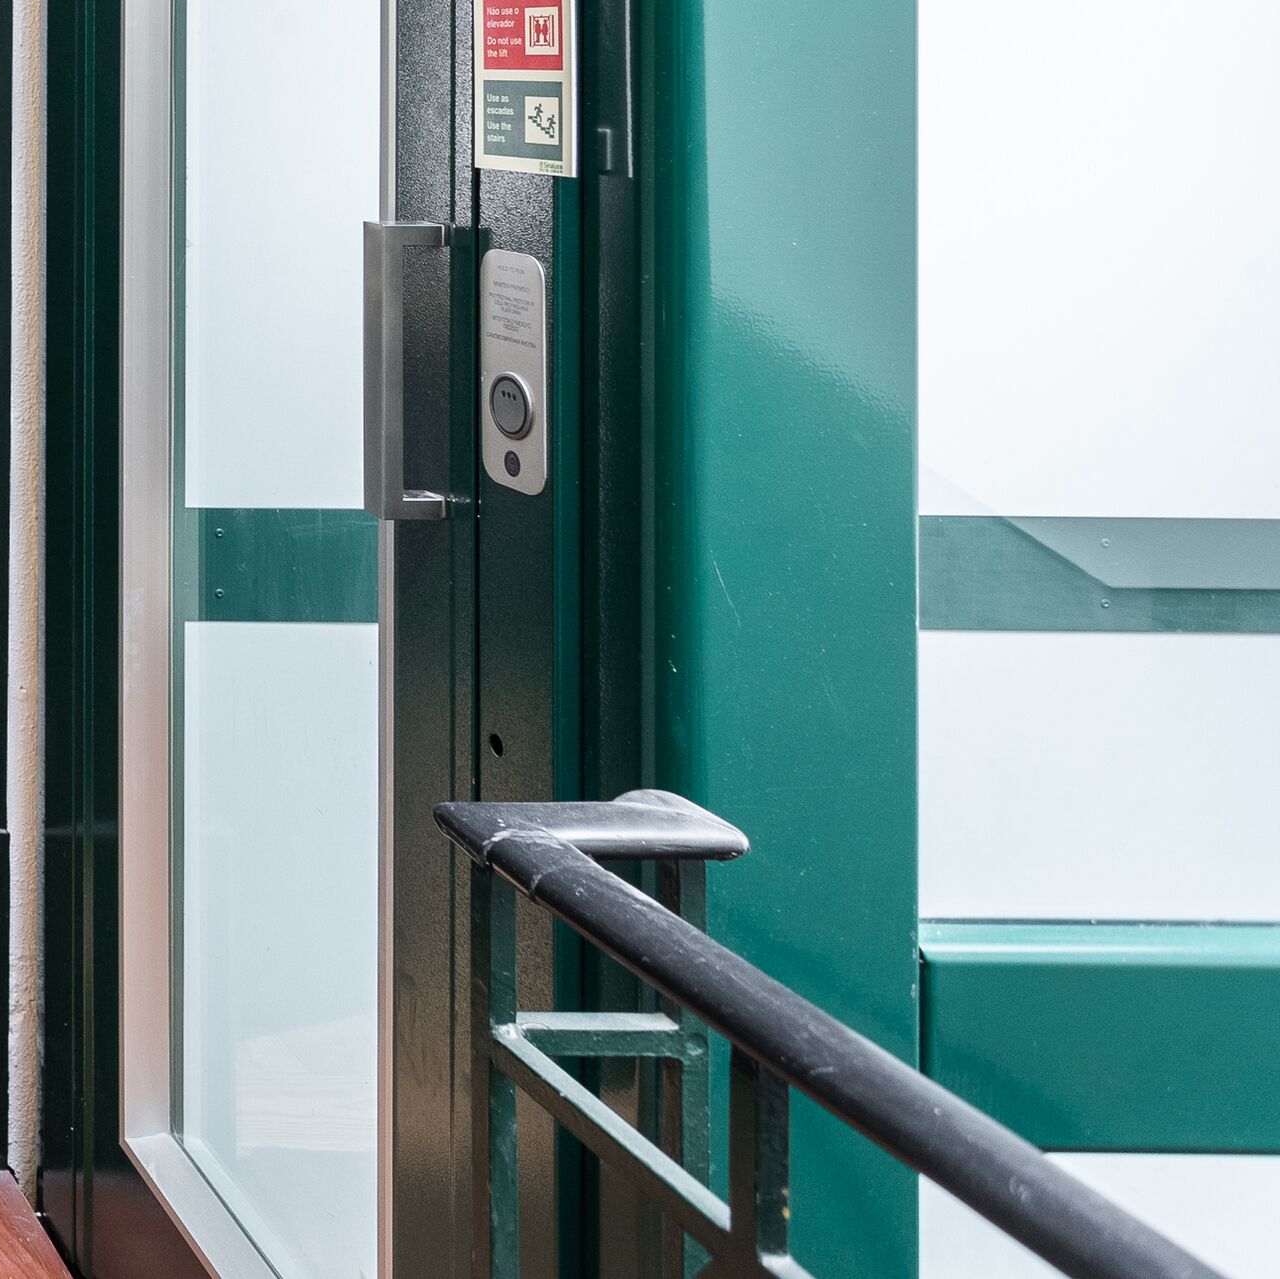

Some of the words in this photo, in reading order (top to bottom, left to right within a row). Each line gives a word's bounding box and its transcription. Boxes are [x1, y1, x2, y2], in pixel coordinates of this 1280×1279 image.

[486, 6, 500, 16] Não
[501, 7, 513, 15] use
[486, 19, 515, 28] elevador
[487, 36, 496, 46] Do
[498, 37, 509, 45] not
[510, 37, 522, 46] use
[487, 48, 498, 58] the
[499, 48, 508, 58] lift
[486, 93, 500, 103] Use
[501, 95, 510, 103] as
[486, 106, 515, 116] escadas
[486, 121, 500, 130] Use
[501, 122, 512, 131] the
[486, 133, 506, 143] stairs
